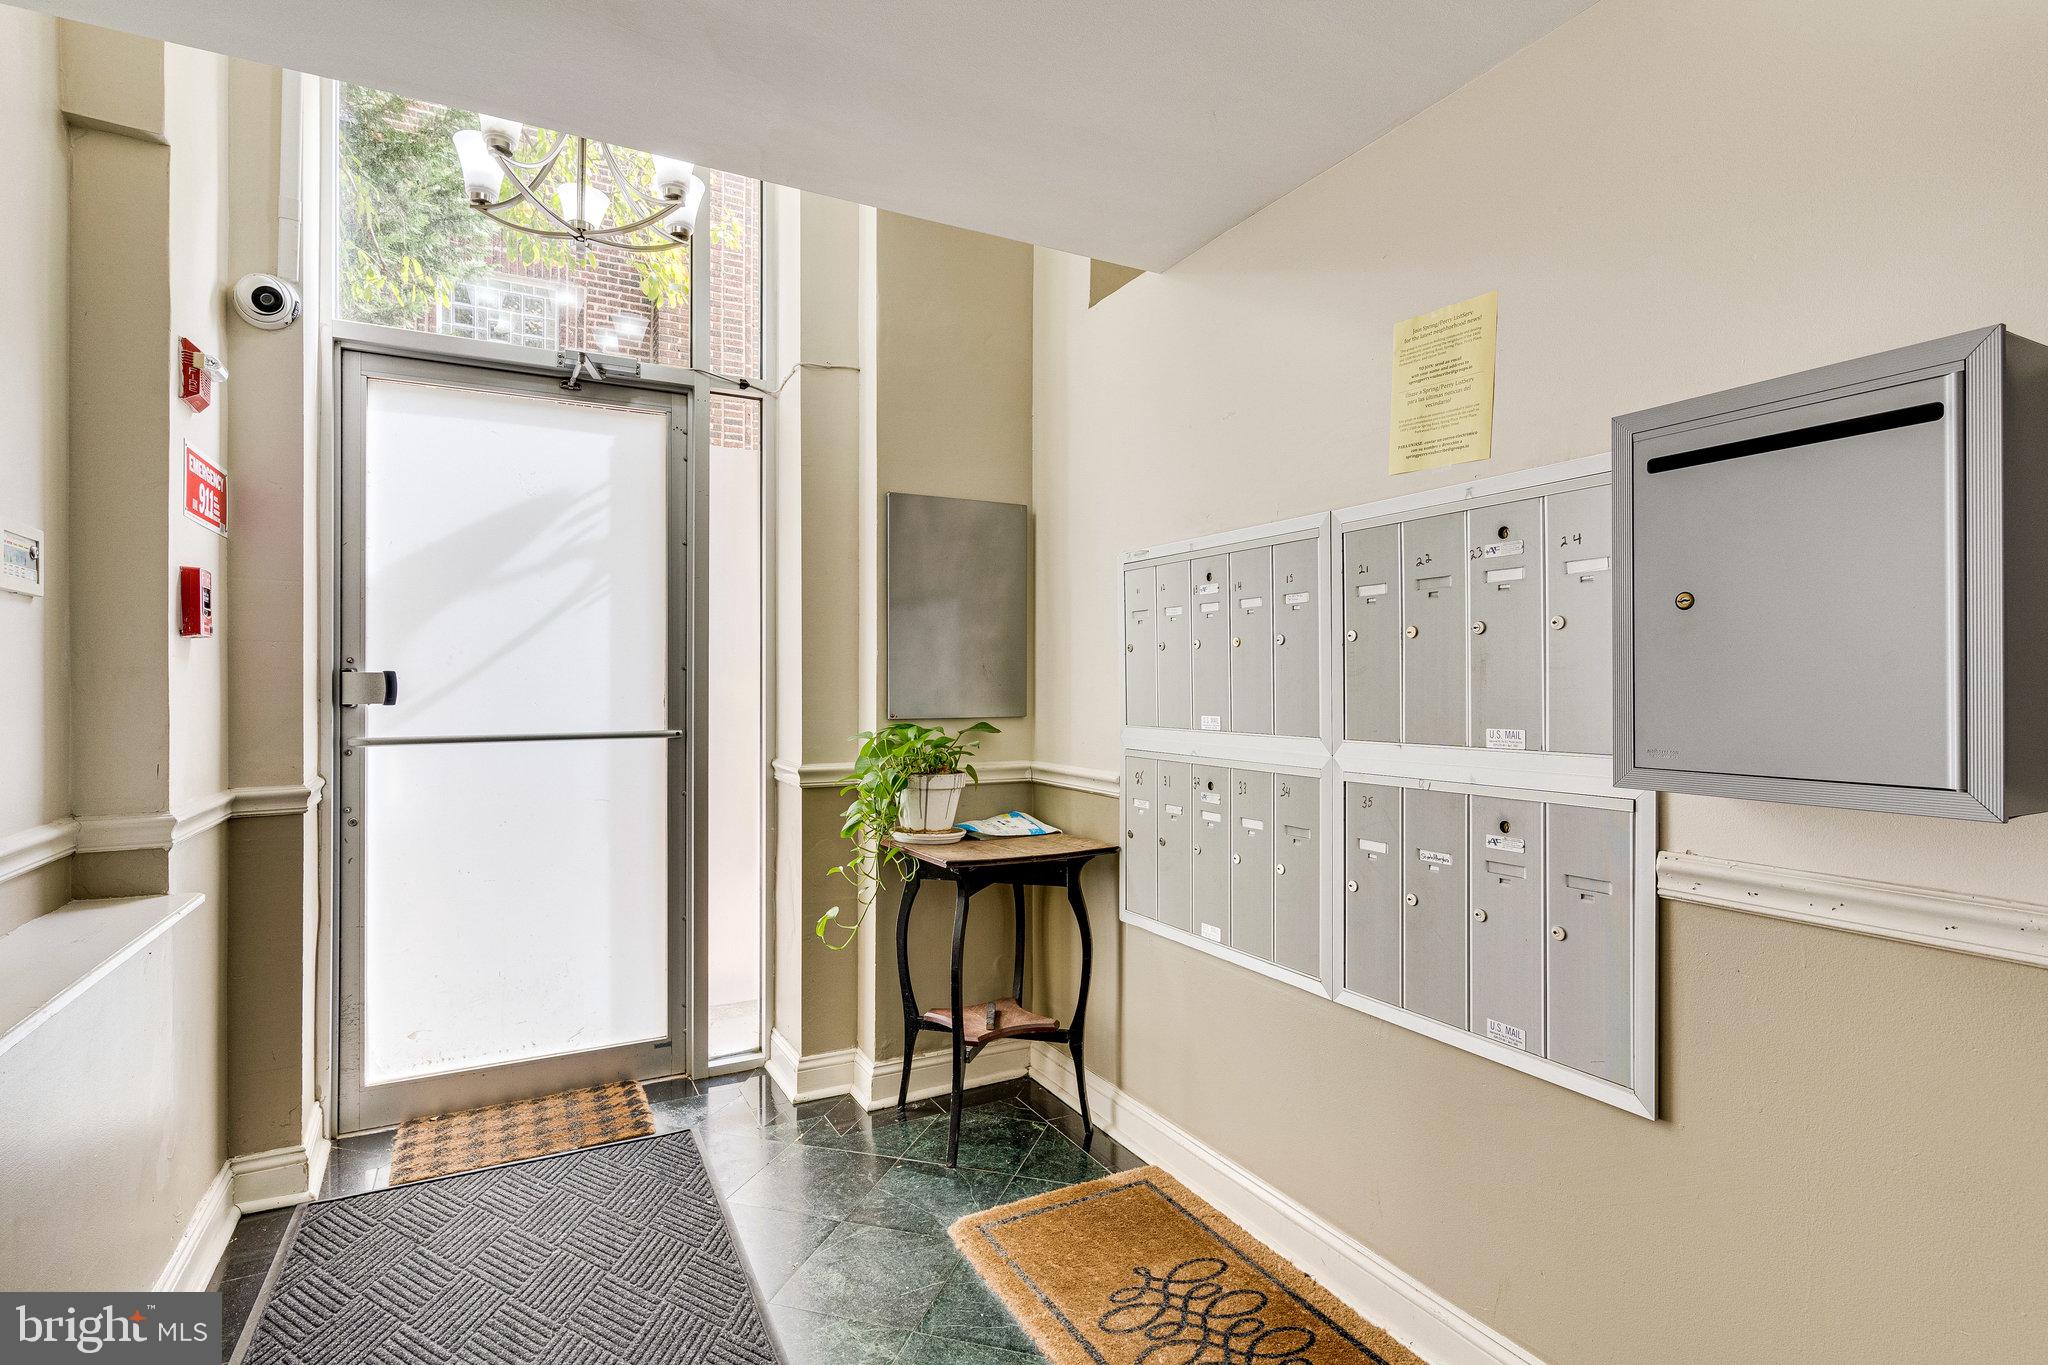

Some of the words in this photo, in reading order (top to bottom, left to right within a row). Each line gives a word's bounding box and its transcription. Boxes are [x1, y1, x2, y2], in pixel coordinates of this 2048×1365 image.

[1432, 319, 1466, 335] neighborhood
[1422, 381, 1454, 395] Spring/Perry
[189, 453, 224, 492] EMERGENCY
[198, 482, 214, 518] 911
[1416, 553, 1432, 567] 22
[1469, 546, 1483, 560] 23
[1358, 564, 1369, 575] 21
[1286, 573, 1294, 584] 15
[1489, 729, 1503, 740] U.S.
[1504, 730, 1522, 741] MAIL
[1238, 780, 1247, 795] 33
[1280, 782, 1291, 798] 34
[1361, 795, 1374, 809] 35
[1489, 1020, 1503, 1033] U.S.
[1504, 1025, 1522, 1041] MAIL
